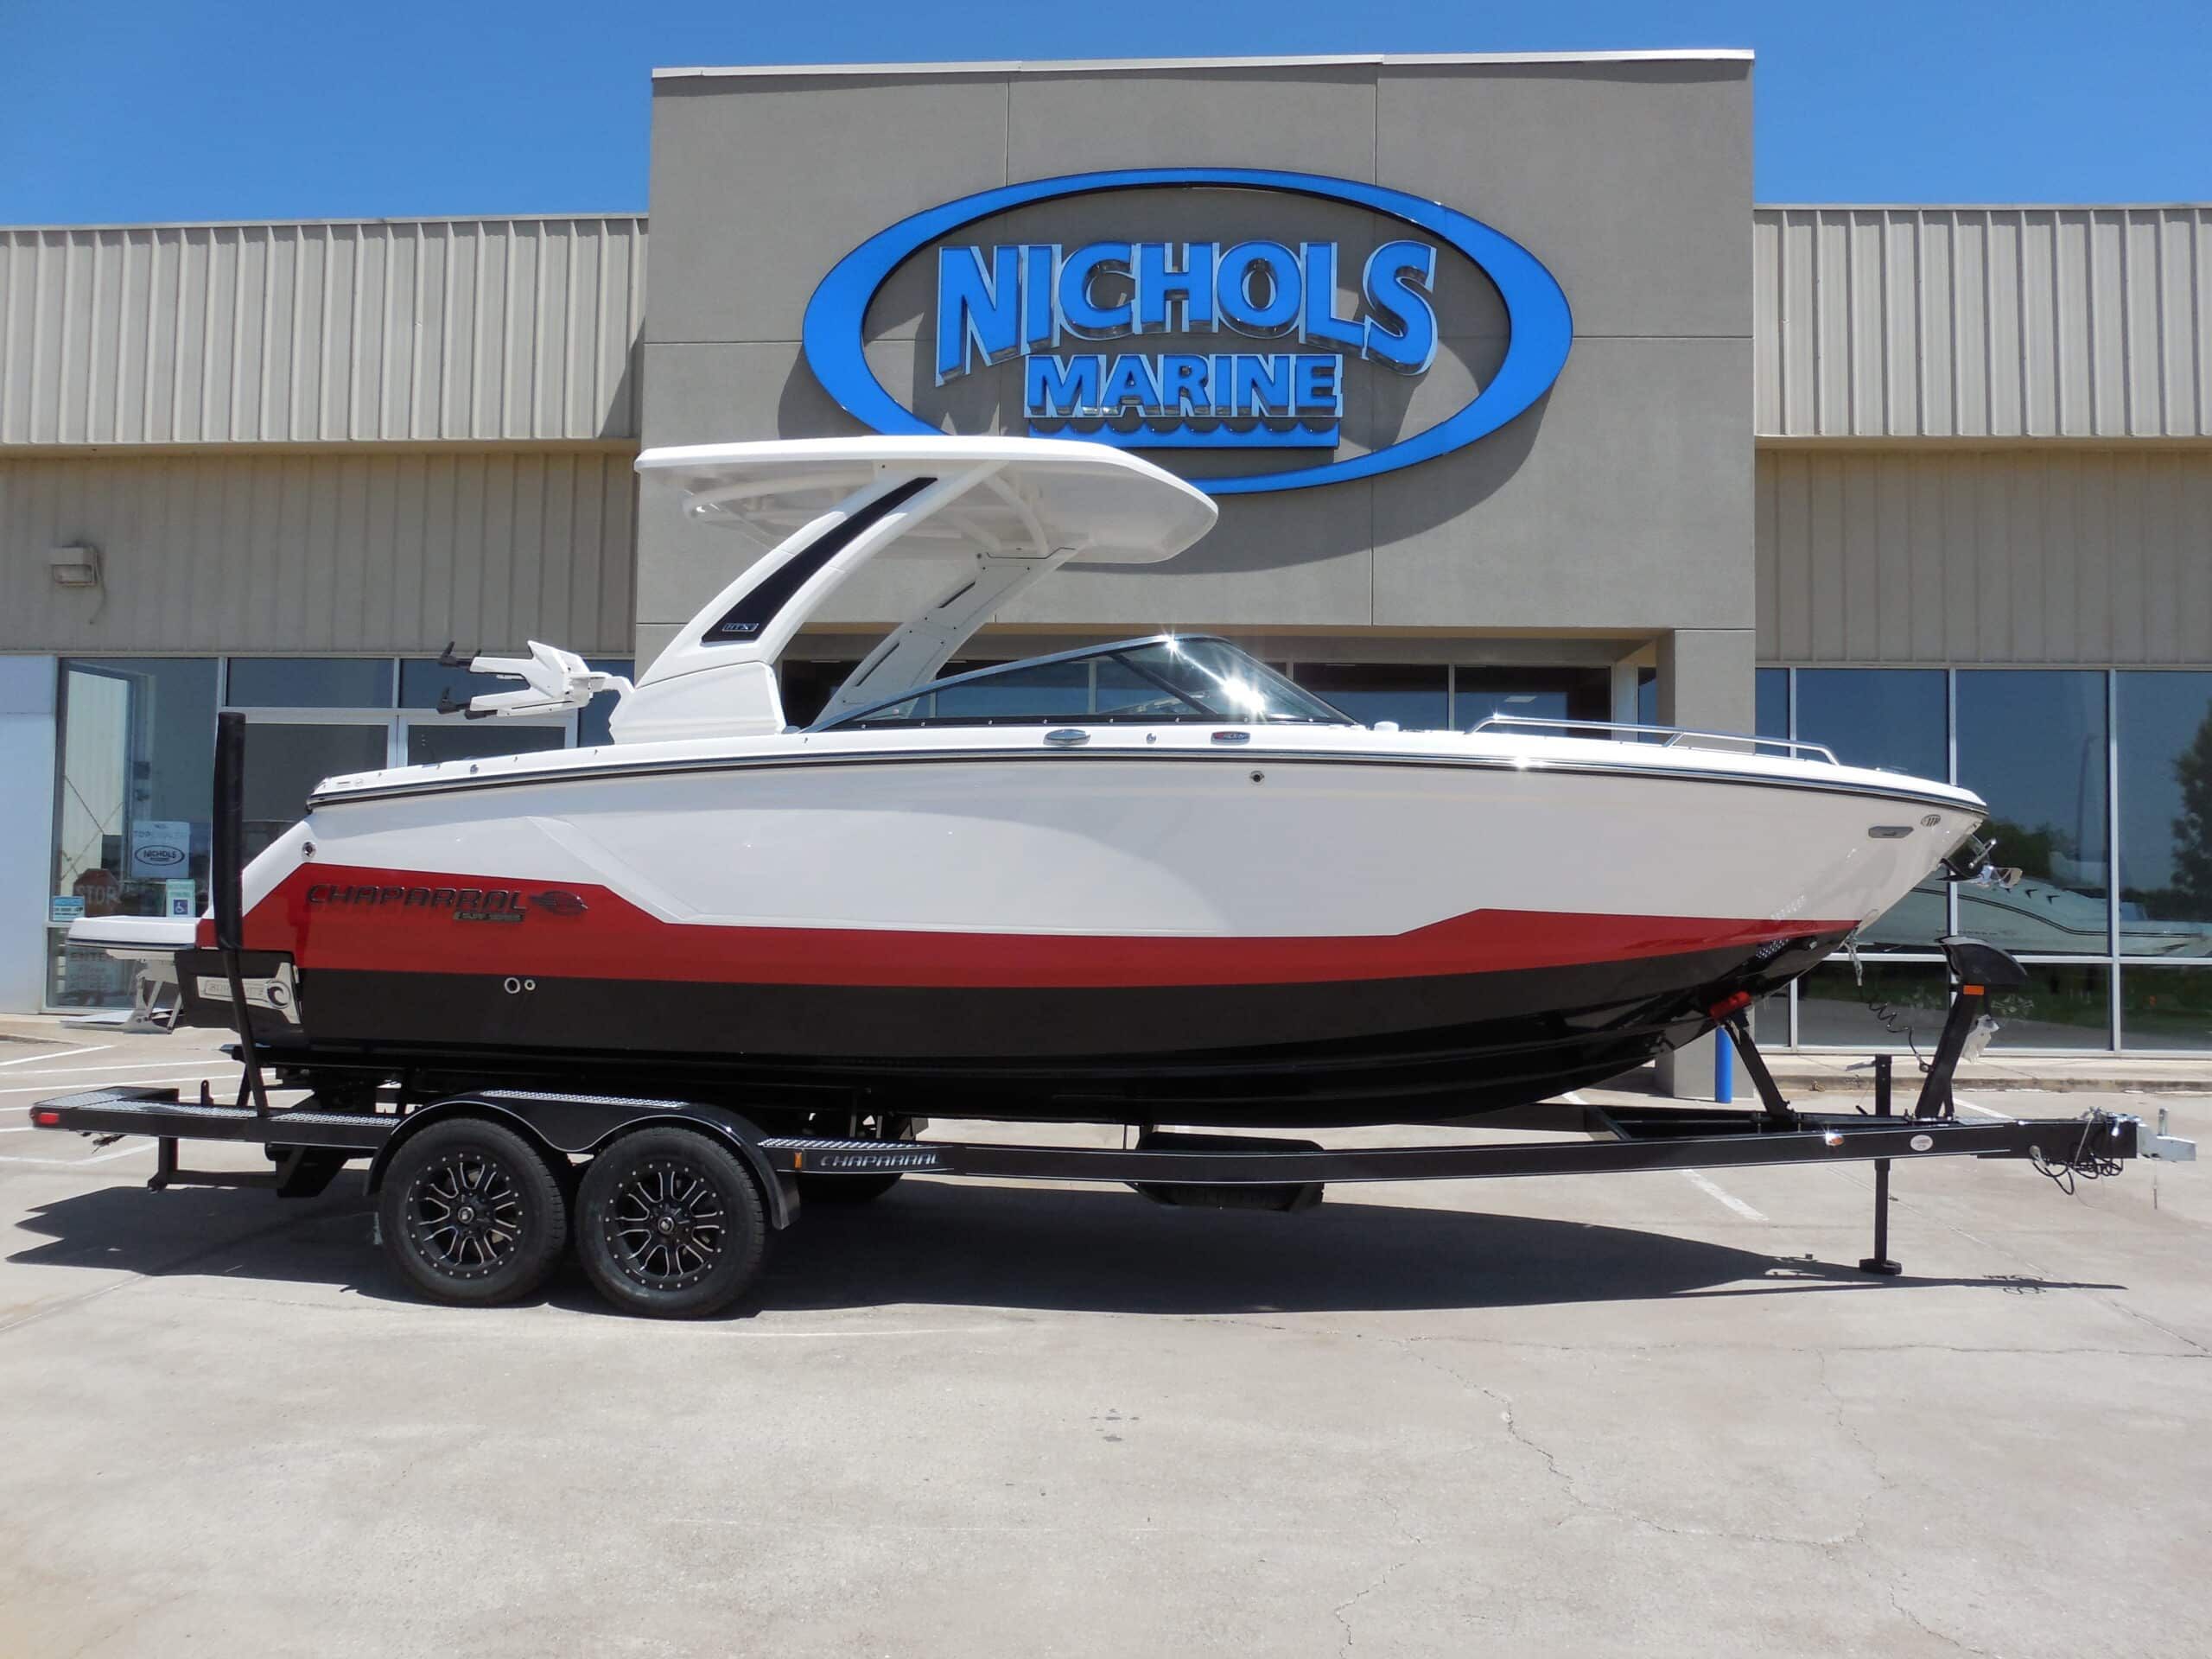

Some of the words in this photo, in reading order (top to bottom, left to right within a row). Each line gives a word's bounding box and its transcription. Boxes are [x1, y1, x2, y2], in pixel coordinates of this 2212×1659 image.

[936, 240, 1438, 387] NICHOLS
[1025, 353, 1343, 417] MARINE
[143, 850, 177, 859] NICHOLS
[307, 884, 526, 910] CHAPARRAL
[820, 1154, 939, 1166] CHAPARRAL
